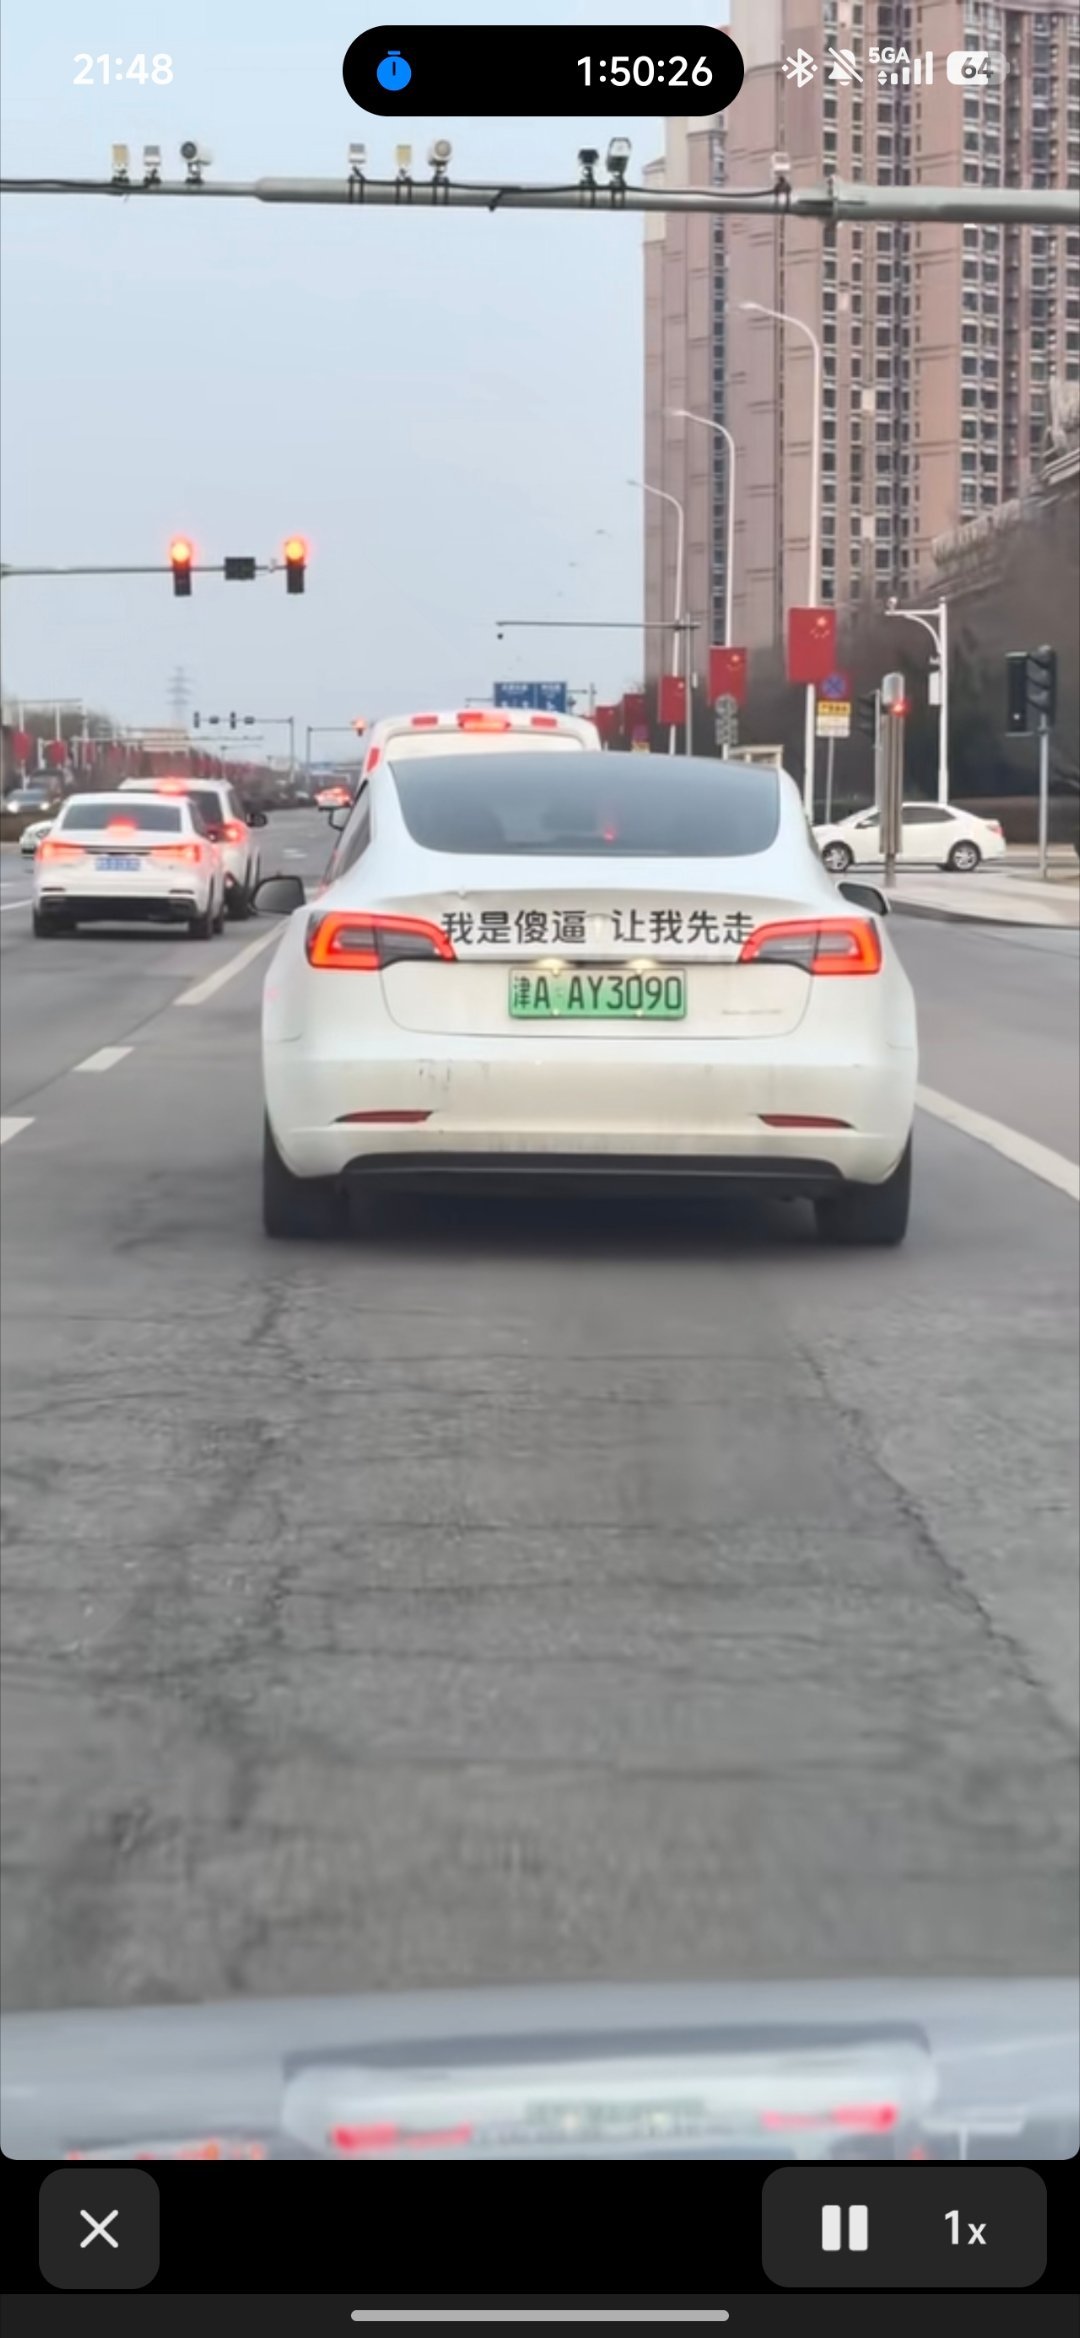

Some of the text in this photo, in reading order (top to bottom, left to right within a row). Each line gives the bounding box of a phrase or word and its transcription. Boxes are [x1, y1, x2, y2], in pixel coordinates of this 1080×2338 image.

[441, 909, 755, 945] 我是傻逼 让我先走
[567, 974, 683, 1011] AY3090
